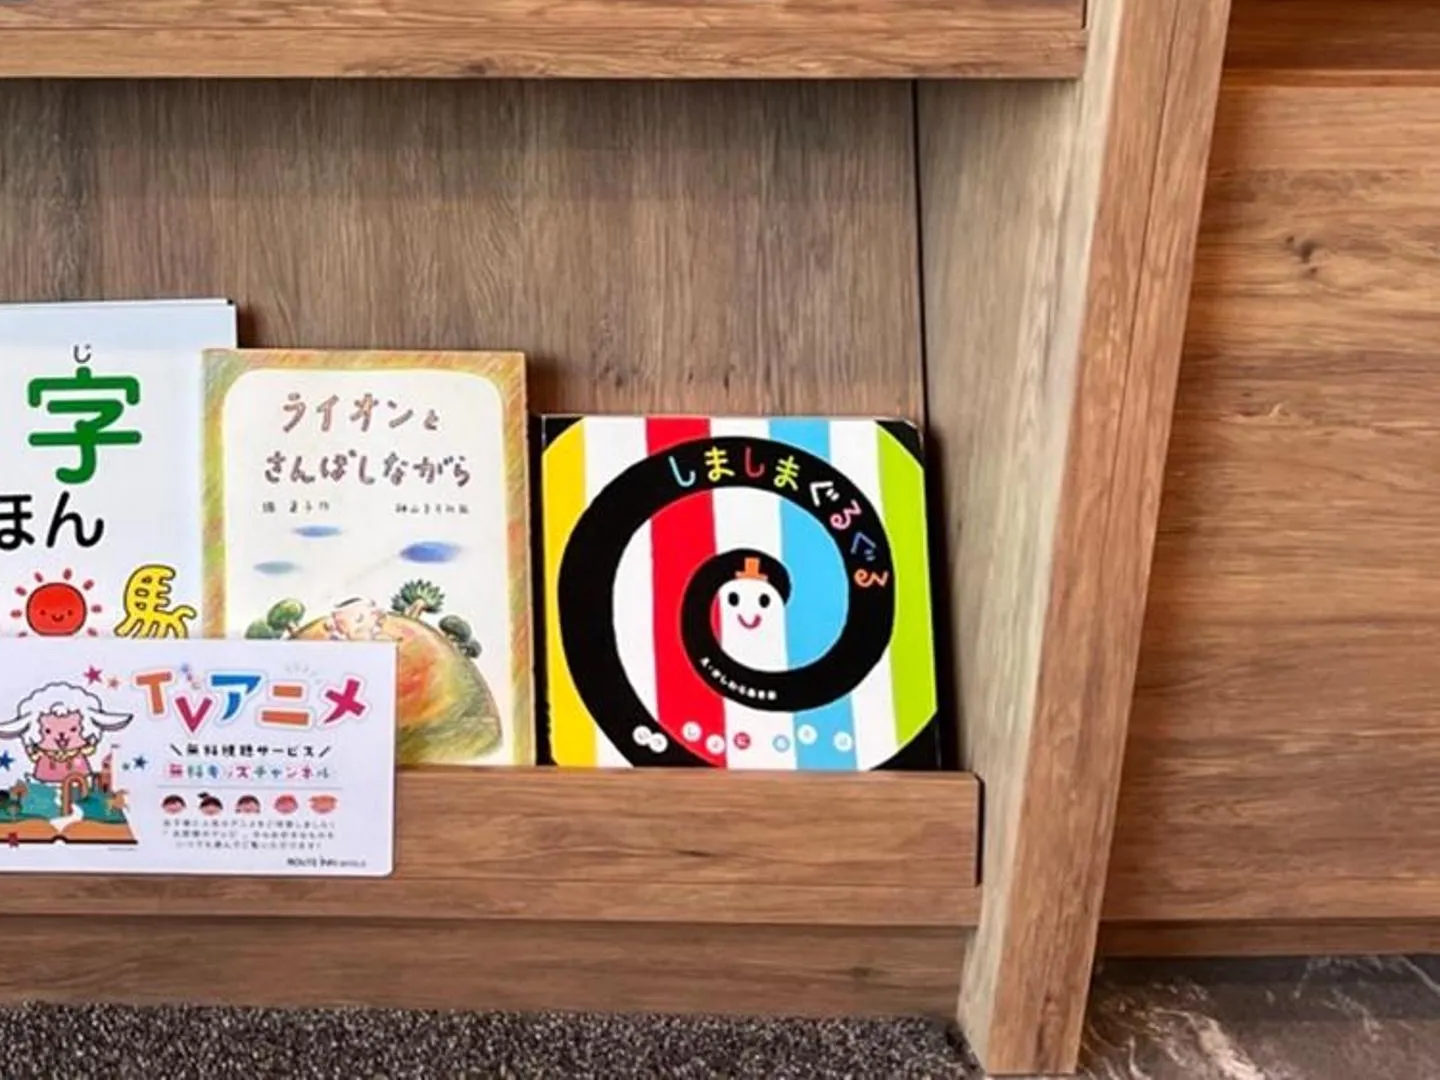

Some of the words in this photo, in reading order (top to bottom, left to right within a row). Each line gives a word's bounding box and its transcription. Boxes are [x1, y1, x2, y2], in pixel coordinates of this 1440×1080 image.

[282, 393, 439, 433] ライオンと
[668, 446, 889, 588] しましまぐるぐる
[136, 672, 366, 733] TVアニメ
